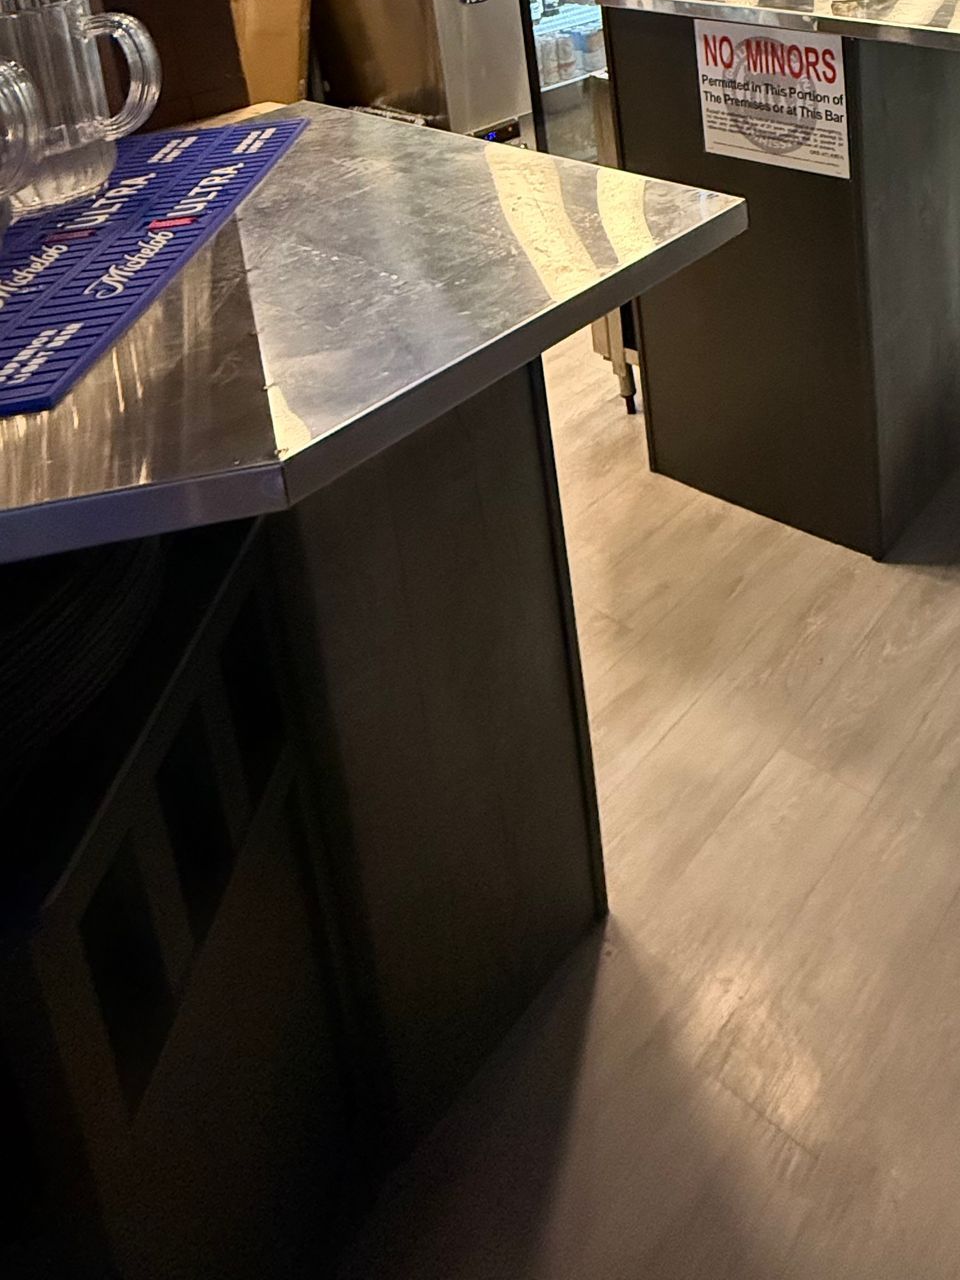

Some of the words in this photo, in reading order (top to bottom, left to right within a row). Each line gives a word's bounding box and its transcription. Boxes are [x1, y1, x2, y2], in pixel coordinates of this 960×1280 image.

[703, 34, 735, 70] NO
[745, 38, 838, 85] MINORS
[701, 74, 750, 92] Permitted
[764, 83, 788, 98] This
[789, 87, 831, 105] Portion
[833, 94, 844, 106] of
[703, 91, 722, 105] The
[723, 95, 771, 113] Premises
[772, 104, 784, 114] or
[786, 105, 798, 117] at
[799, 106, 823, 120] This
[824, 110, 845, 124] Bar
[62, 172, 157, 230] ULTRA
[82, 230, 174, 300] Michelob
[167, 162, 245, 218] ULTRA
